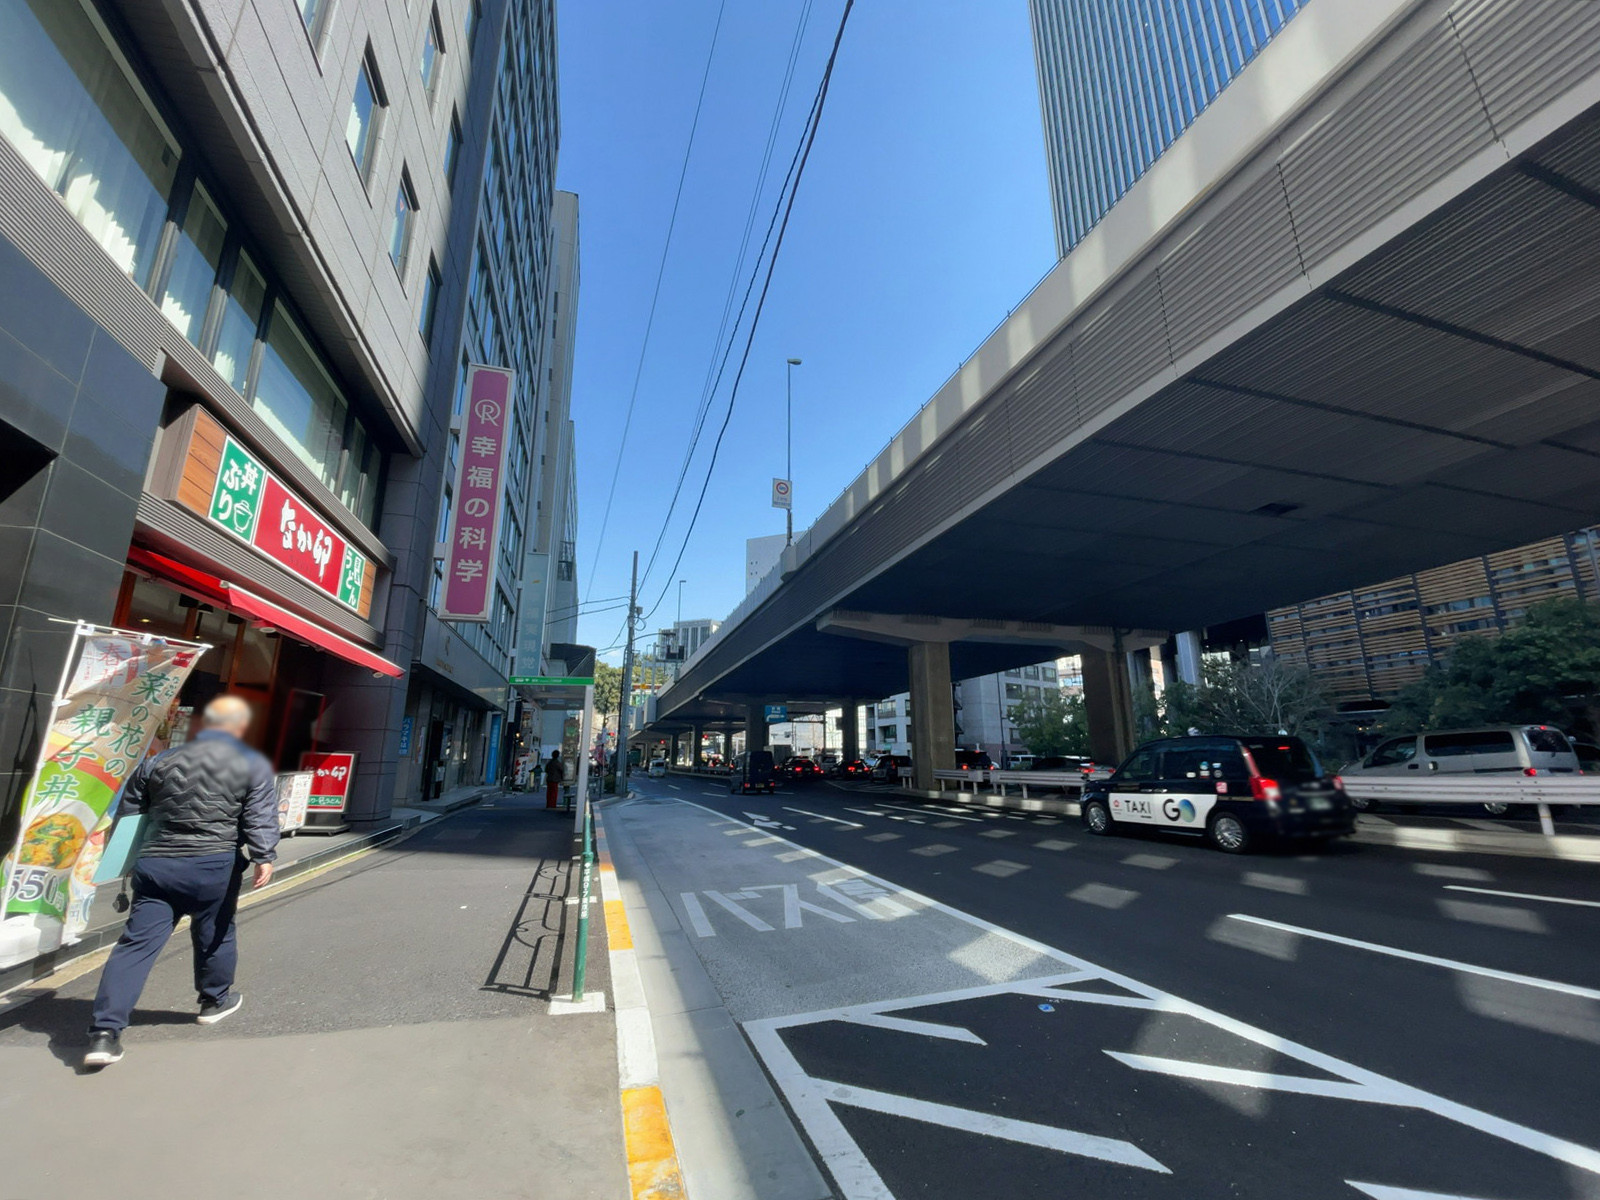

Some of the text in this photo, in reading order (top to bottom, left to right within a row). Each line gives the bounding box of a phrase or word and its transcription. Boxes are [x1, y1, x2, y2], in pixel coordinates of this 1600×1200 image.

[280, 499, 332, 583] なか卯
[455, 436, 497, 582] 幸福の科学
[36, 703, 116, 808] 親子丼
[104, 671, 170, 778] 菜の花の
[1124, 798, 1196, 823] TAXI GO
[680, 879, 921, 938] バス停
